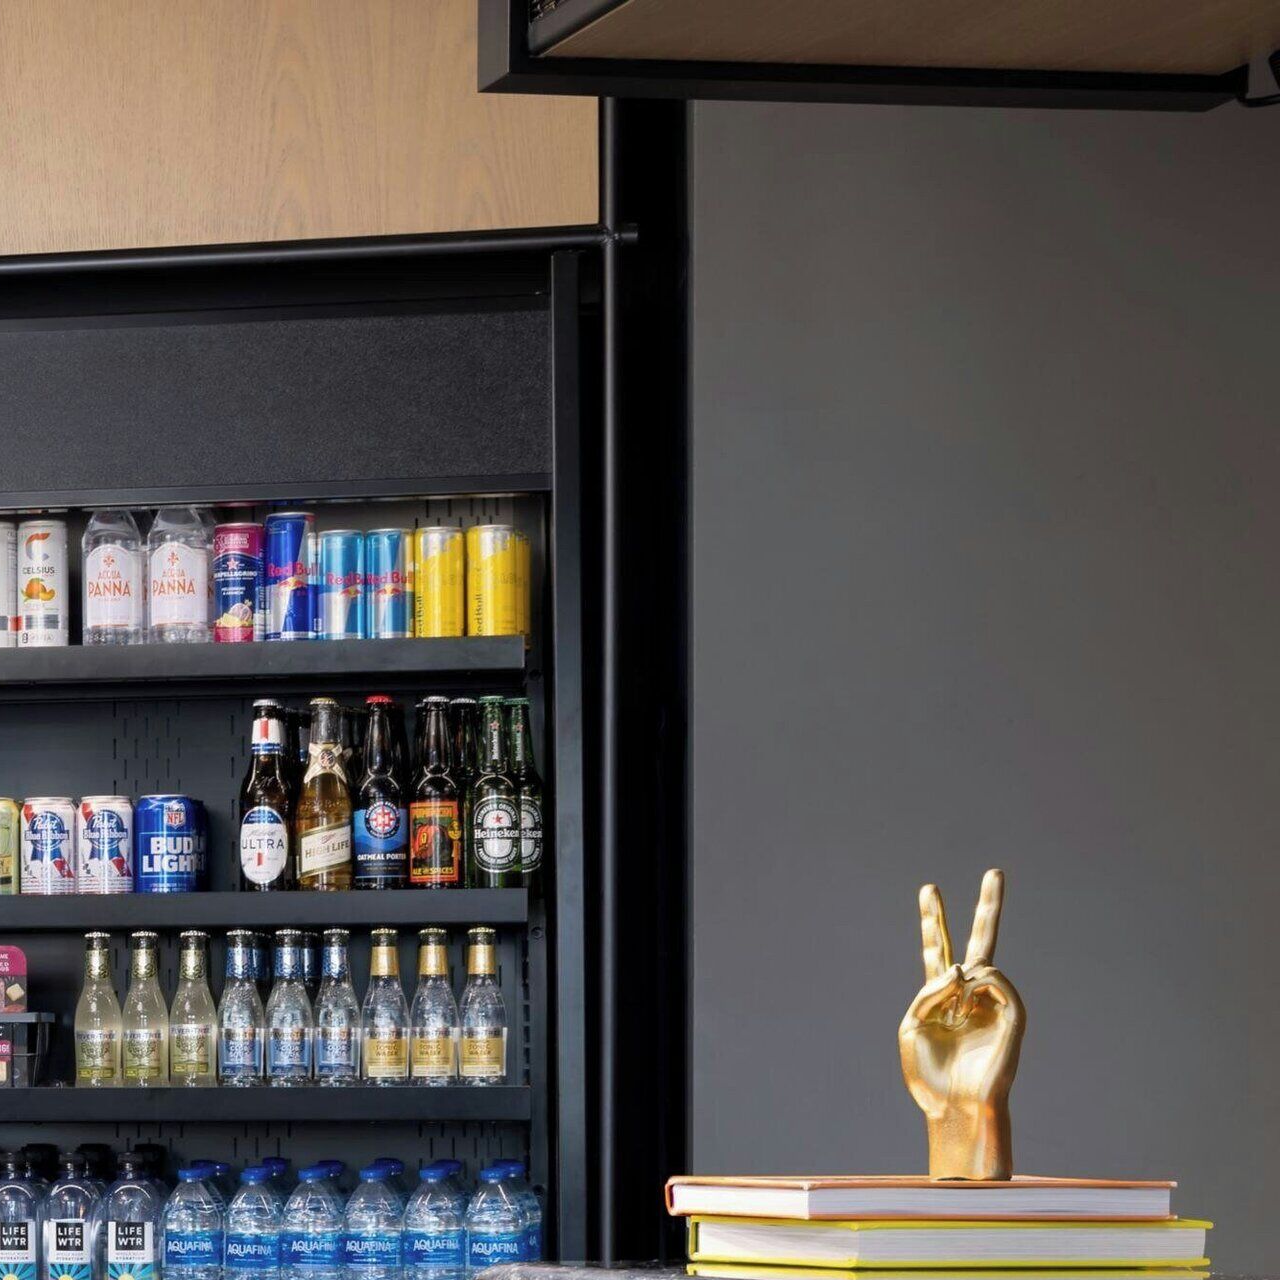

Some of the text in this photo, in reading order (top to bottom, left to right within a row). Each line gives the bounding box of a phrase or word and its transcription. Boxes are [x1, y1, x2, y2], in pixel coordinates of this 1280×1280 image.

[268, 562, 293, 577] Red
[88, 580, 131, 597] PANNA
[152, 578, 196, 596] PANNA
[167, 813, 183, 824] NFL
[25, 831, 68, 840] Blue Ribbon
[83, 830, 127, 840] Blue Ribbon
[151, 837, 194, 855] BUD
[242, 838, 285, 850] ULTRA
[332, 840, 350, 853] LIFE
[143, 855, 199, 873] LIGHT
[2, 1226, 27, 1236] LIFE
[58, 1226, 81, 1236] LIFE
[118, 1226, 142, 1236] LIFE
[2, 1236, 27, 1247] WTR
[167, 1241, 214, 1255] AQUAFINA
[290, 1240, 337, 1254] AQUAFINA
[227, 1241, 273, 1257] AQUAFINA
